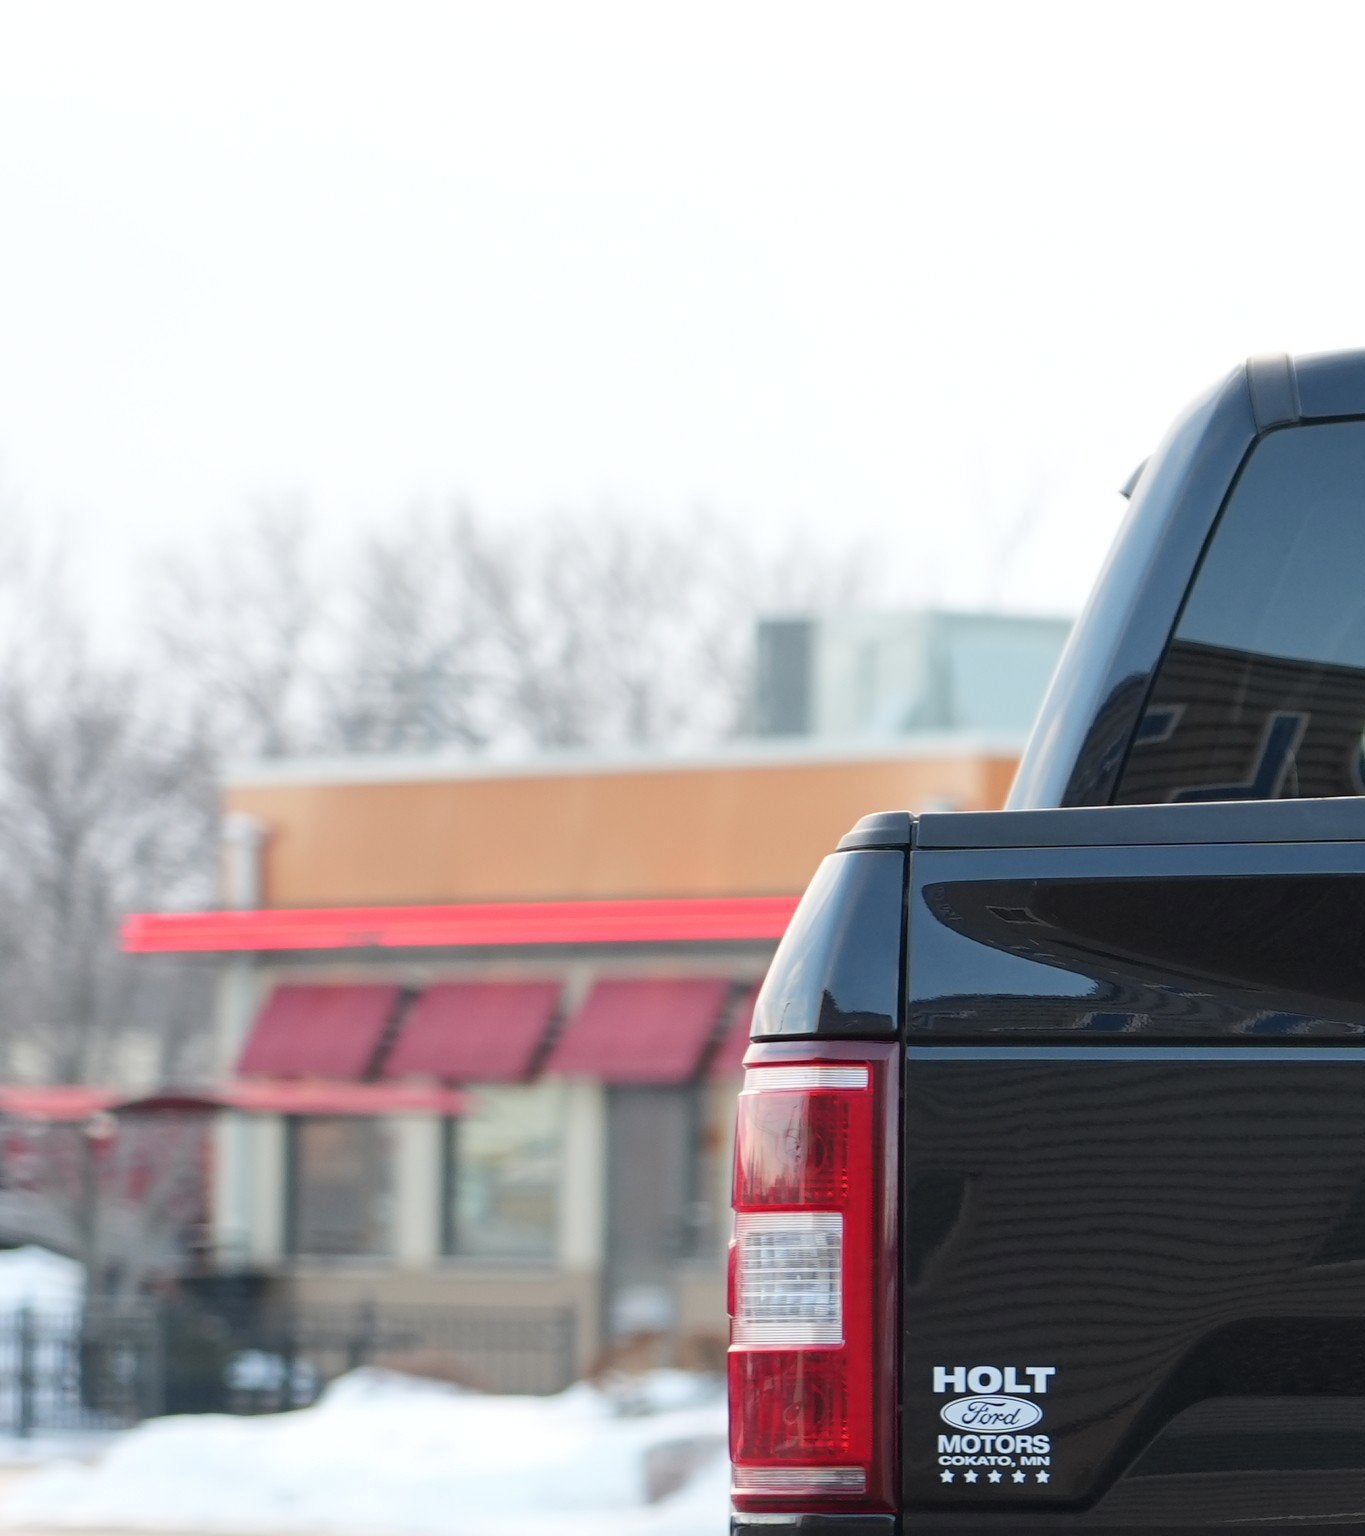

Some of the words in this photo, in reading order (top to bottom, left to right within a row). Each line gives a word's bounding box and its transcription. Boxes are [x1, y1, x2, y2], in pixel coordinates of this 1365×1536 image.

[933, 1366, 1056, 1394] HOLT
[962, 1401, 1021, 1425] Ford
[937, 1434, 1050, 1454] MOTORS
[938, 1455, 1017, 1468] COKATO,
[1020, 1456, 1050, 1466] MN
